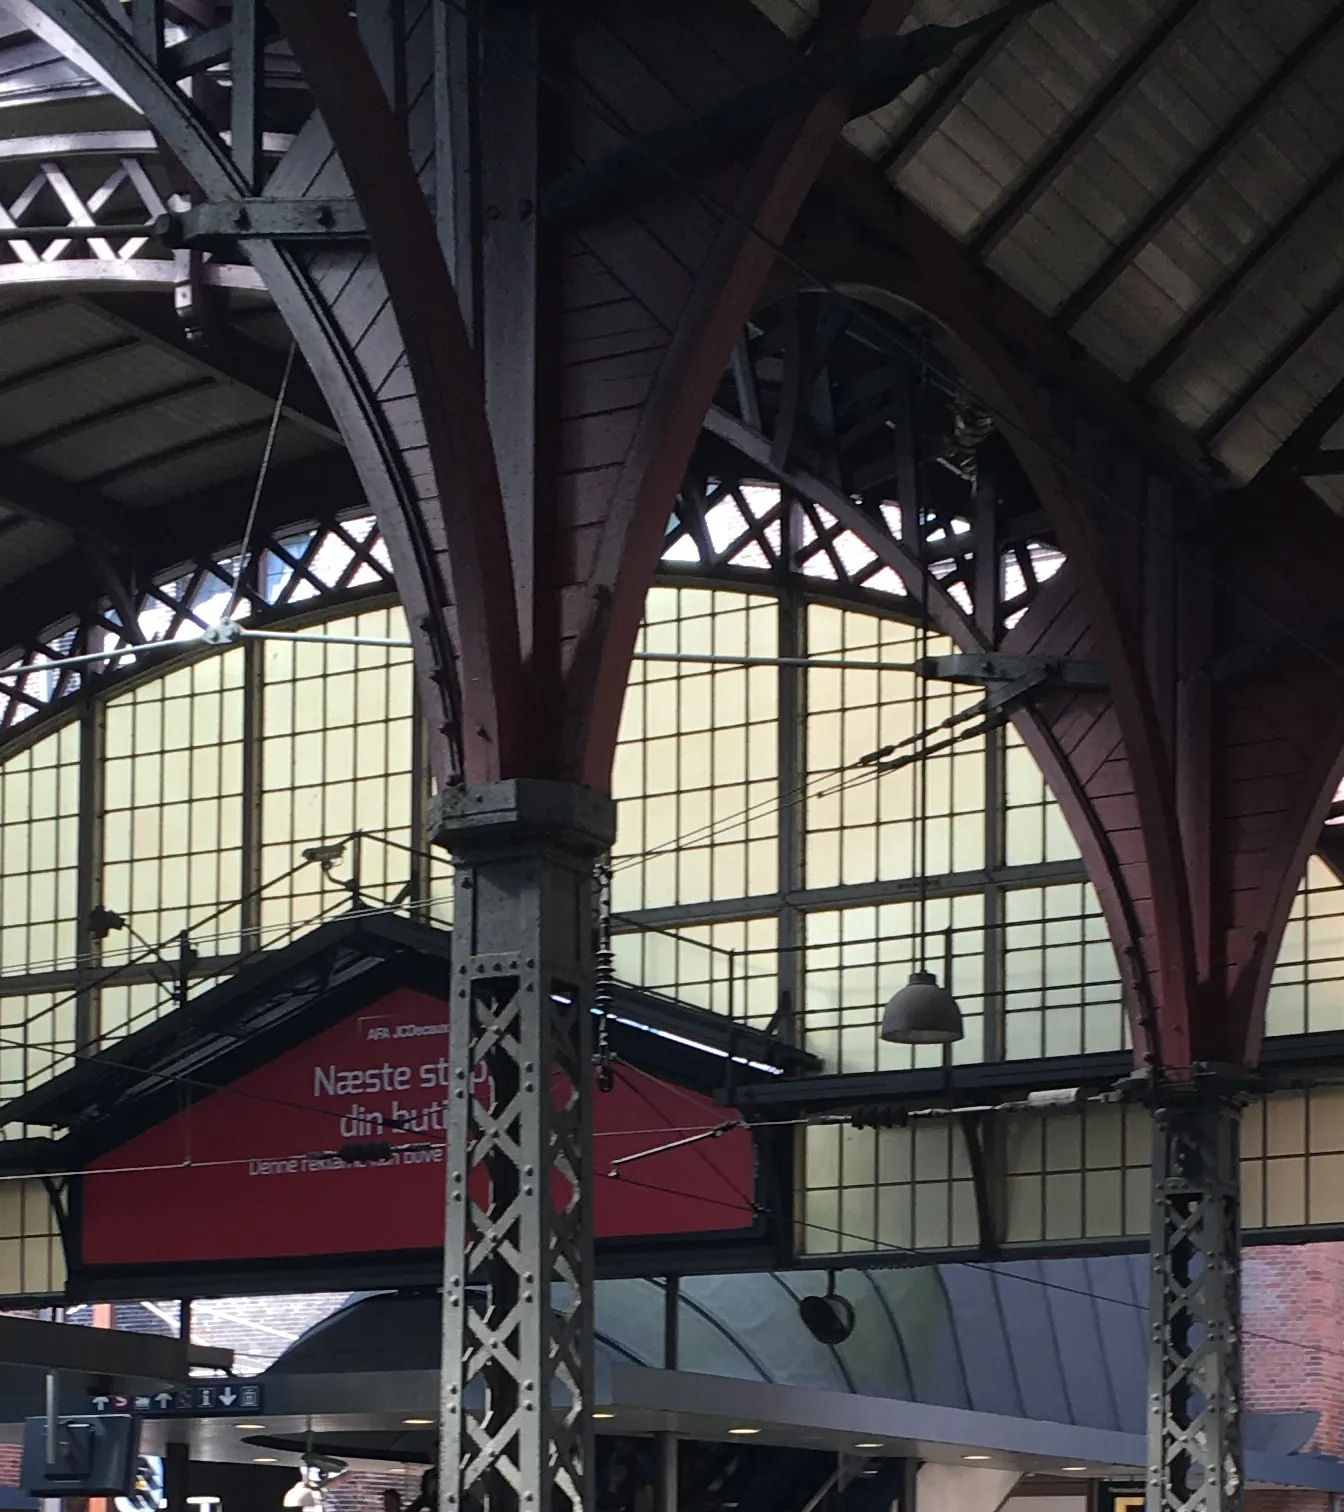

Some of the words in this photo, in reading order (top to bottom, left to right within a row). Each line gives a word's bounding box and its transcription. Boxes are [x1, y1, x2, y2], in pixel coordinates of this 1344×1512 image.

[313, 1062, 411, 1097] Næste
[340, 1103, 384, 1138] din
[391, 1099, 450, 1134] buti
[249, 1158, 298, 1176] Denne
